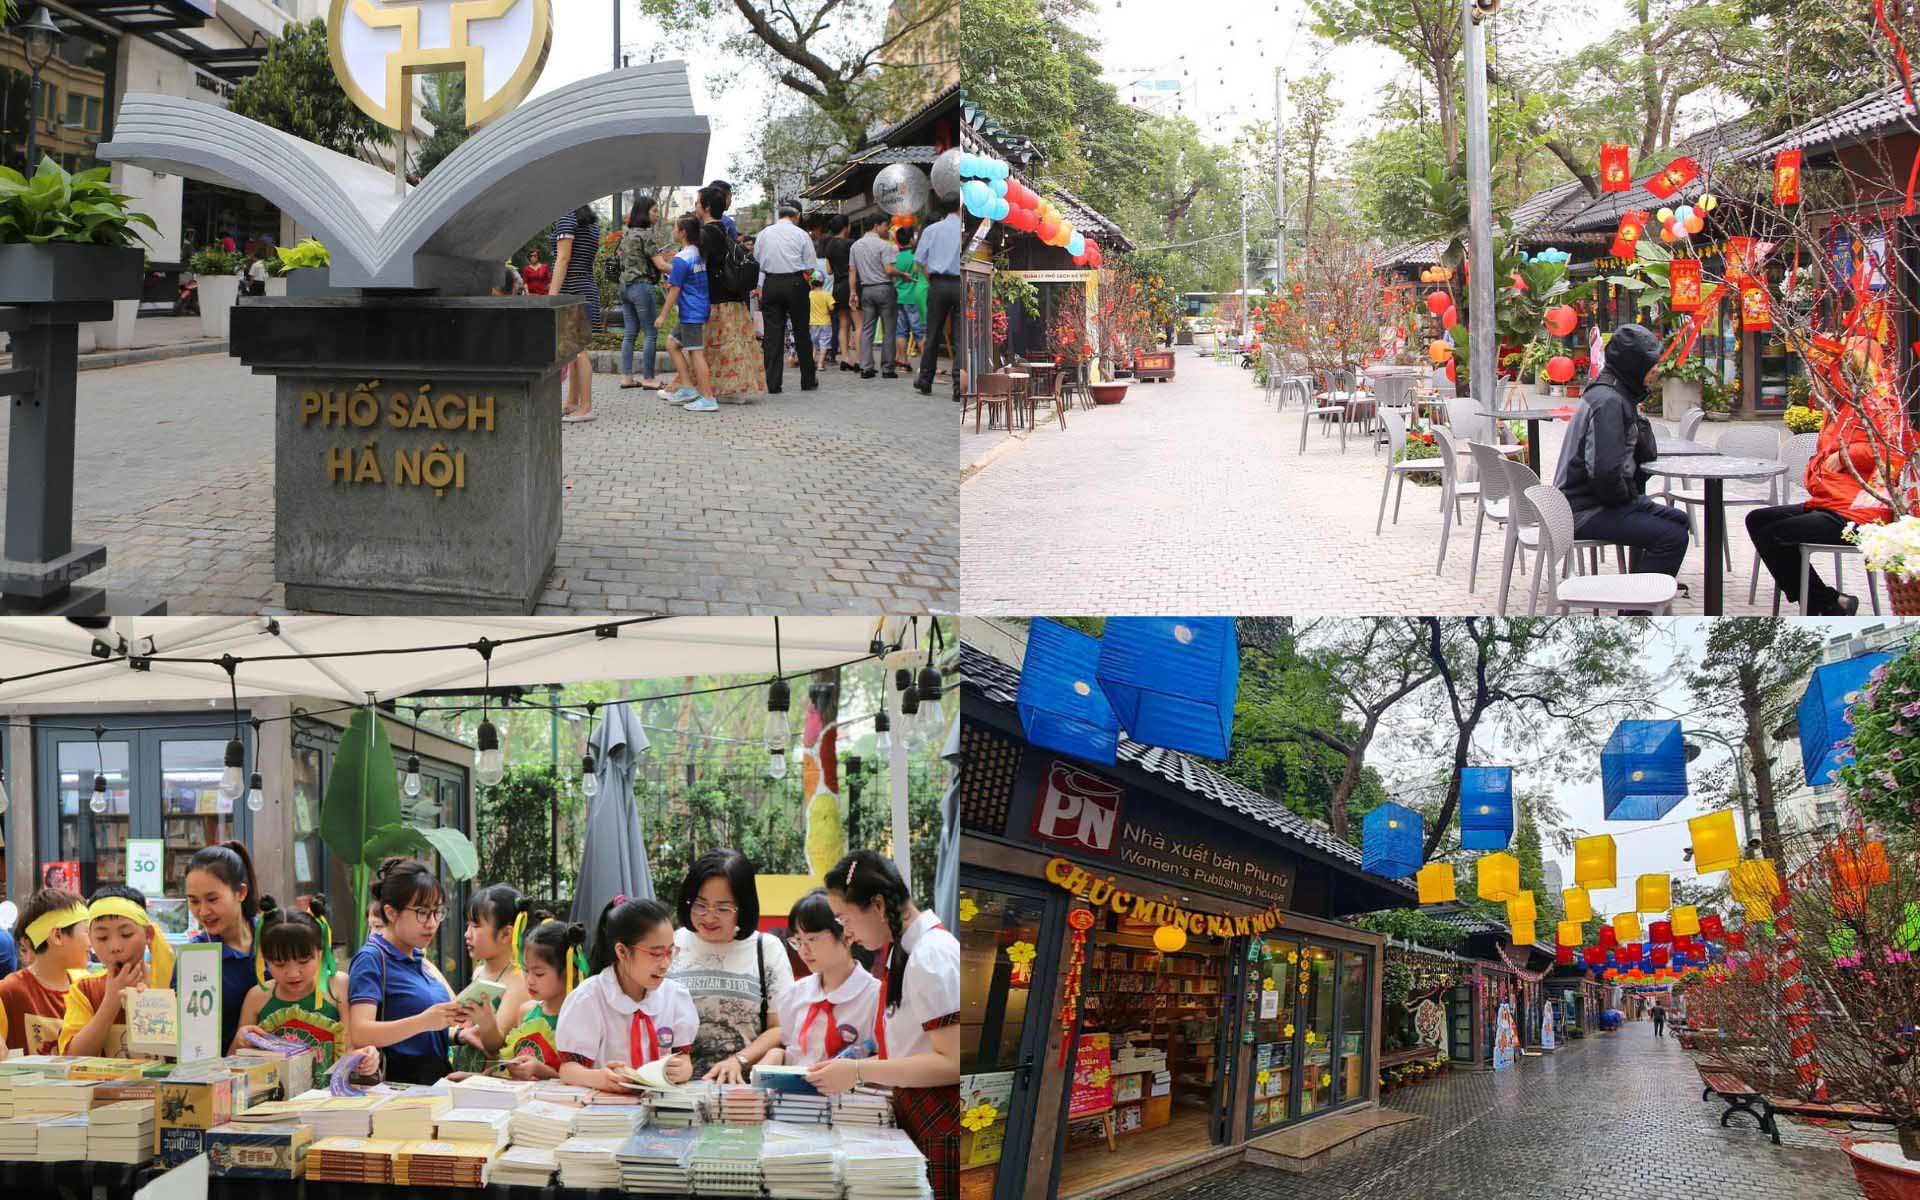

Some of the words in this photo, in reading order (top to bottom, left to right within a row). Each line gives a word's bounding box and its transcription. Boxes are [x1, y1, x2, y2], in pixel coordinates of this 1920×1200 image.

[302, 379, 381, 426] PHỐ
[387, 383, 496, 432] SÁCH
[395, 442, 466, 497] NỘI
[1038, 784, 1117, 850] PN
[1123, 822, 1166, 850] Nhà
[1170, 842, 1209, 865] xuất
[1046, 856, 1131, 914] CHÚC
[1129, 895, 1205, 935] MỪNG
[1206, 909, 1251, 937] NĂM
[1120, 847, 1189, 878] Women's
[1193, 867, 1253, 897] Publishing
